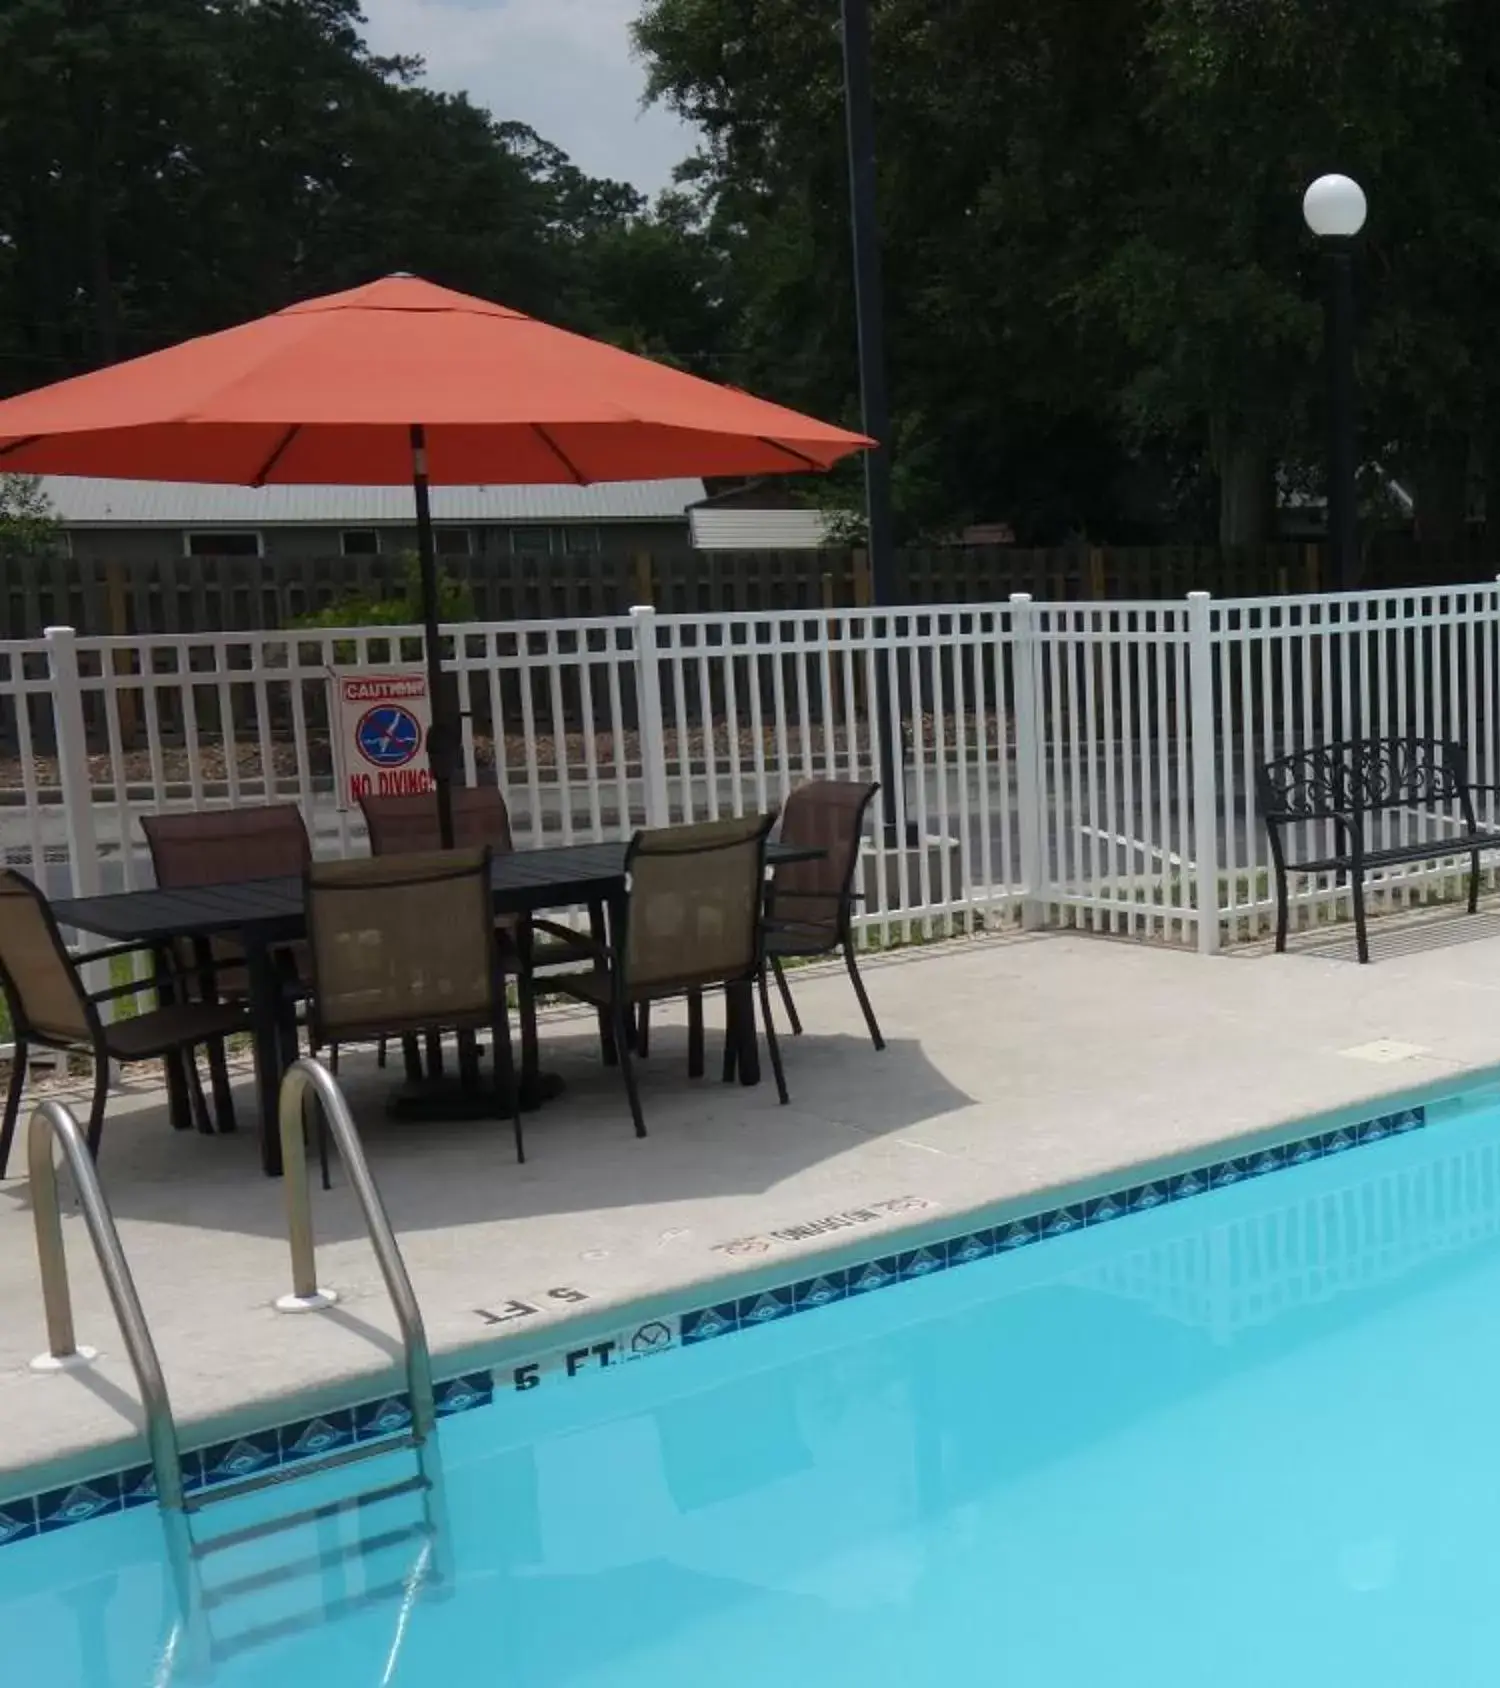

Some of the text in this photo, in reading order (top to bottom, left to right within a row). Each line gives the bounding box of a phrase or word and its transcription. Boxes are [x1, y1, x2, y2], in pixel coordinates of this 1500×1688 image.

[350, 773, 372, 800] NO
[472, 1286, 590, 1326] 5 FT
[513, 1363, 540, 1391] 5
